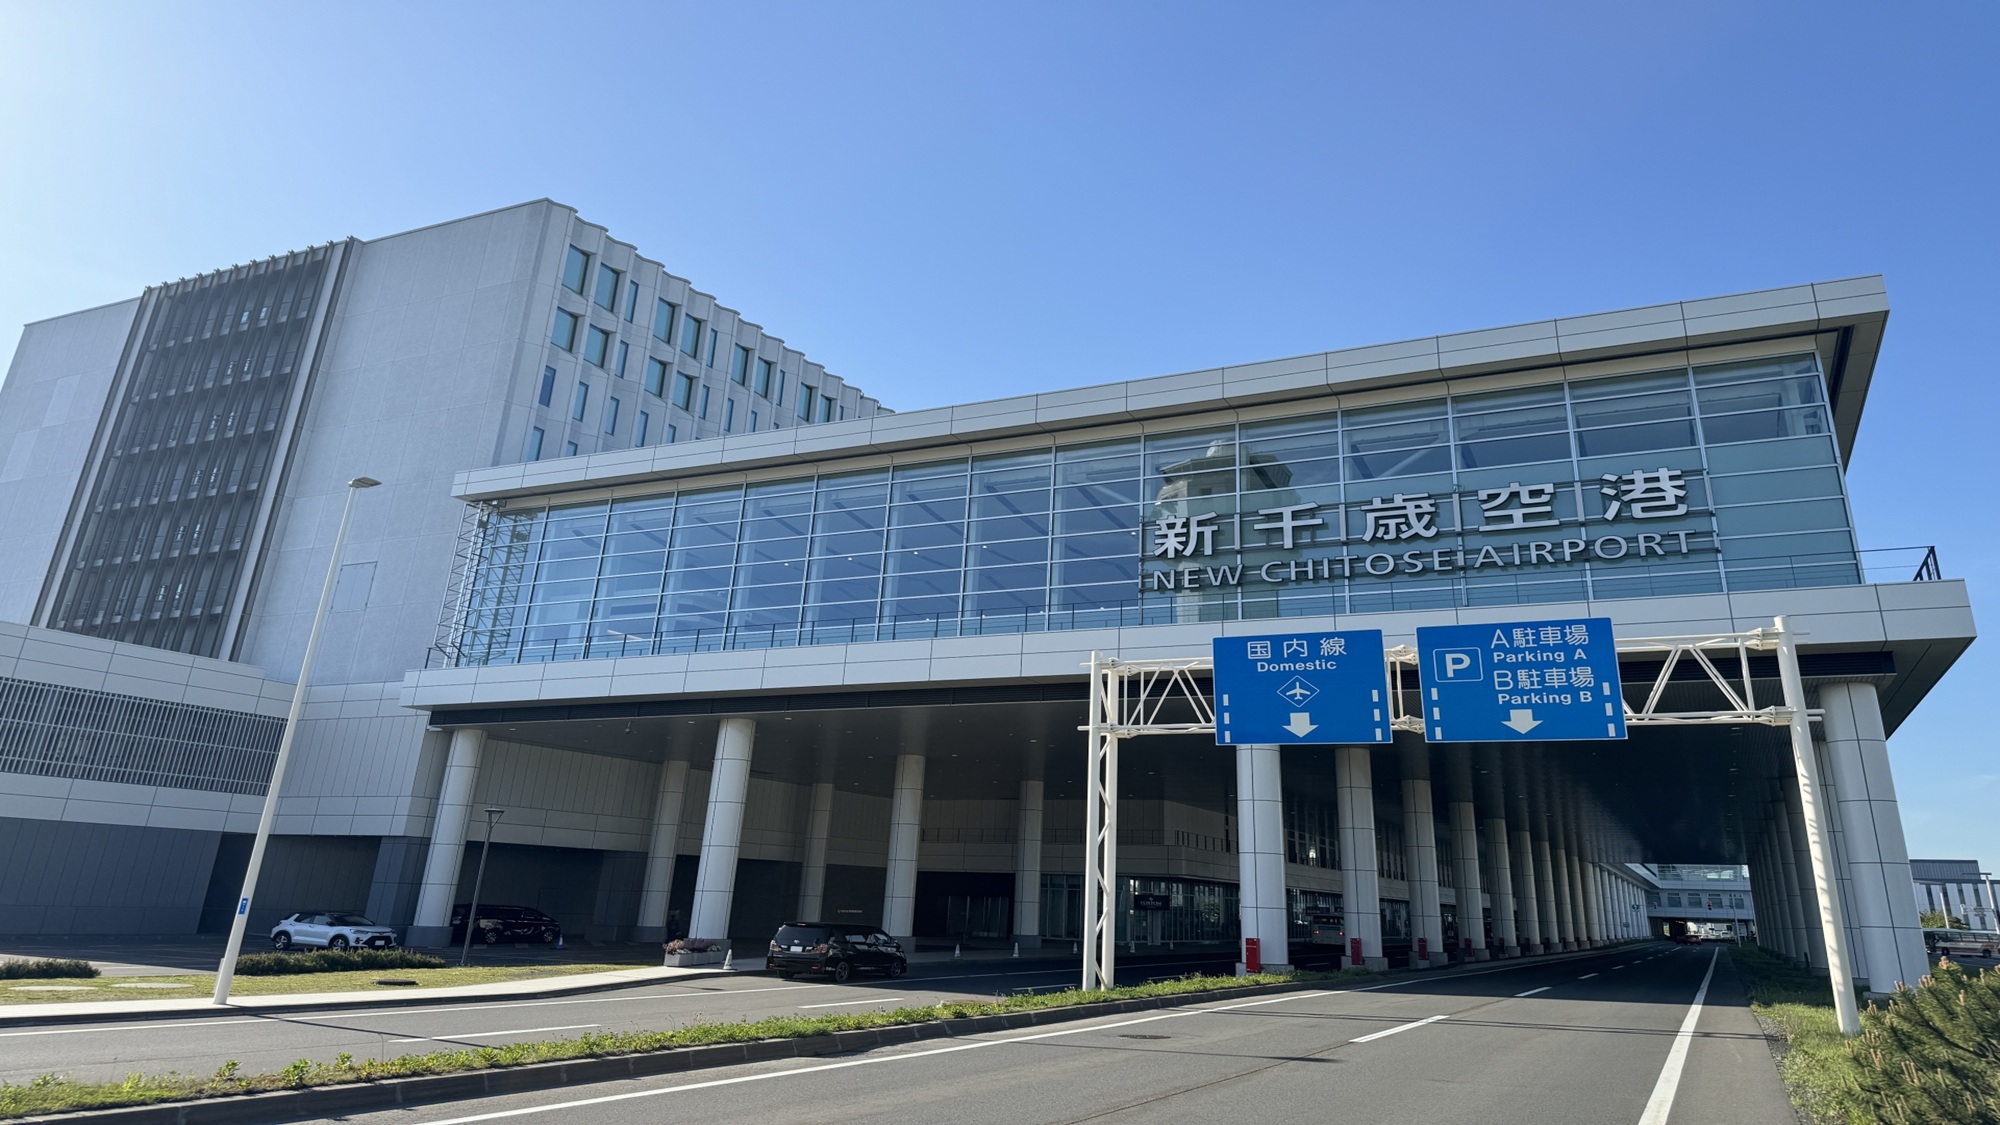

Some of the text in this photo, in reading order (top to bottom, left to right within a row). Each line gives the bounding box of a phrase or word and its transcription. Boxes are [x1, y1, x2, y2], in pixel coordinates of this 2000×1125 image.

[1153, 466, 1688, 559] 新千歳空港
[1153, 529, 1696, 591] NEW CHITOSE AIRPORT
[1247, 637, 1347, 660] 国内線
[1490, 624, 1590, 649] A駐車場
[1256, 659, 1338, 673] Domestic
[1445, 652, 1471, 678] P
[1493, 648, 1588, 664] Parking A
[1493, 666, 1595, 691] B駐車場
[1497, 690, 1593, 706] Parking B
